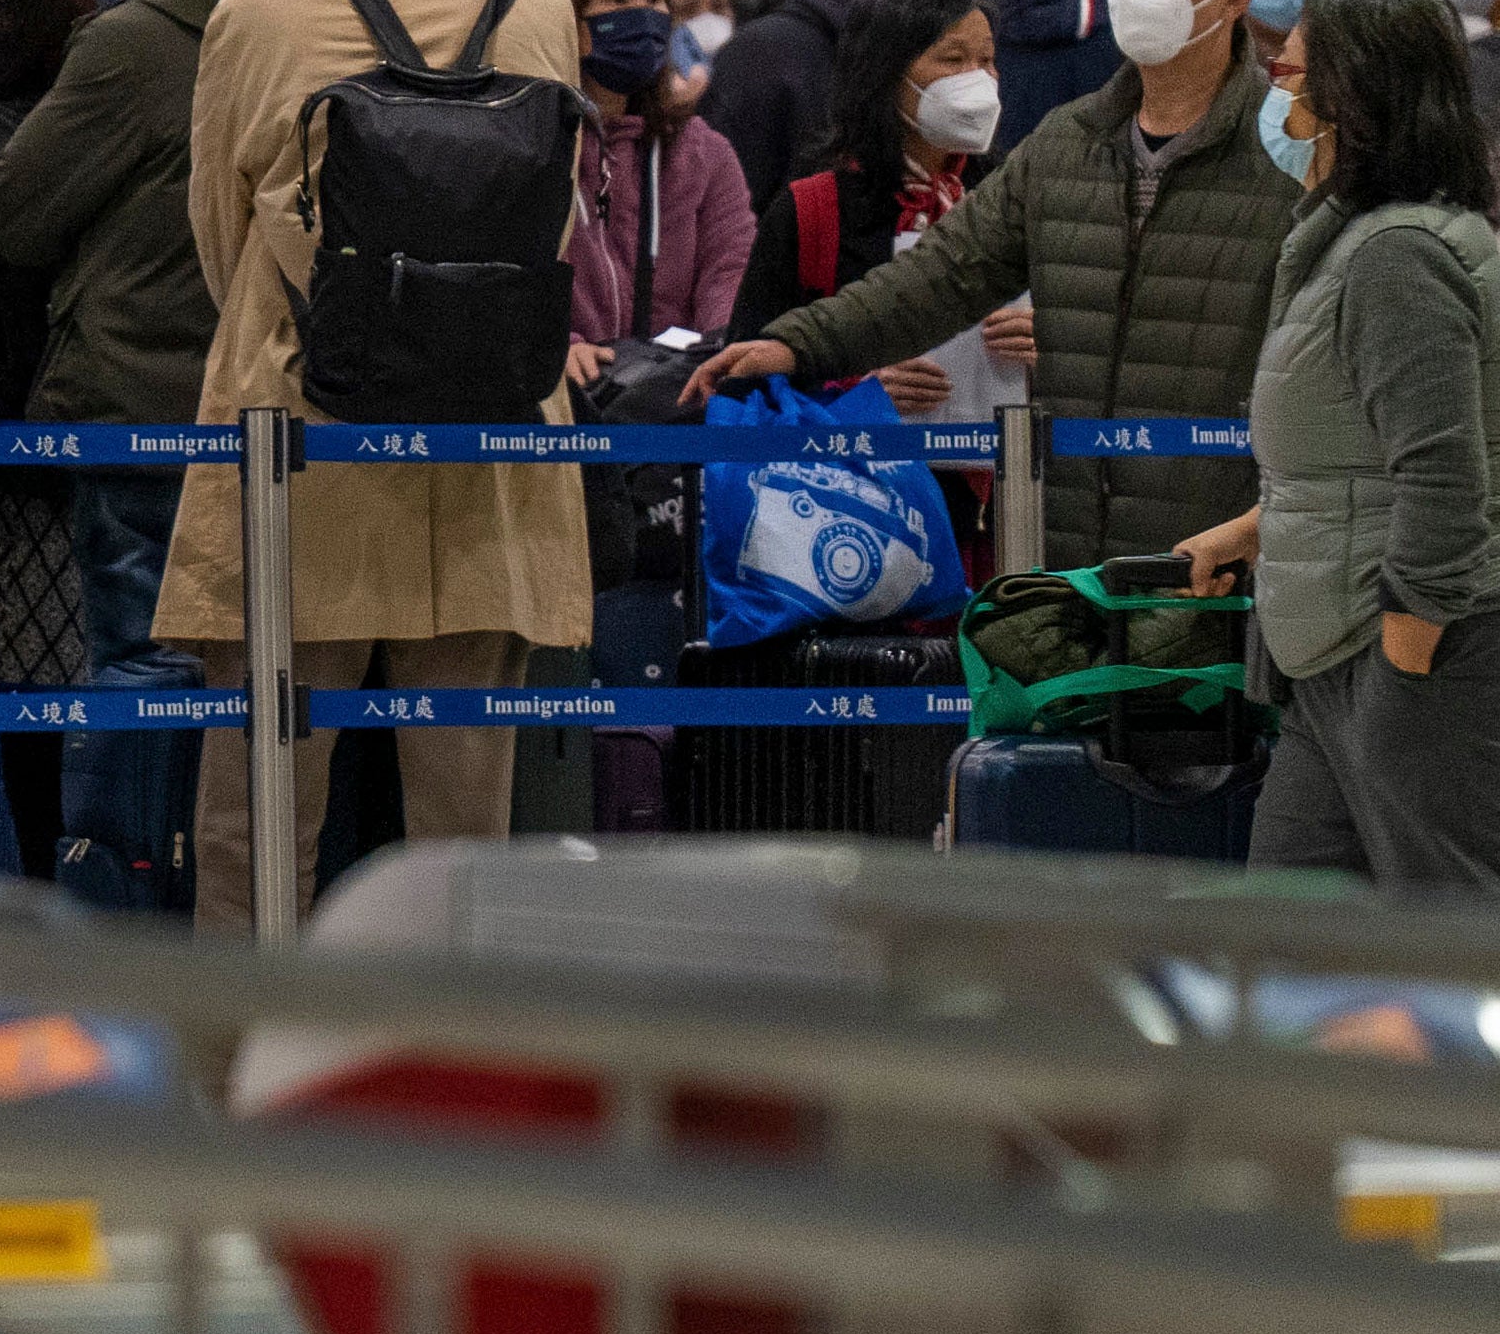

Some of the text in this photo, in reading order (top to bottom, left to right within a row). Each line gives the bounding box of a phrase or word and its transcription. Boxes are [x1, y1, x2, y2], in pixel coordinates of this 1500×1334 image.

[10, 433, 82, 458] 入境處
[356, 431, 430, 457] 入境處
[479, 430, 612, 455] Immigration
[801, 432, 875, 457] 入境處
[1094, 425, 1153, 451] 入境處
[15, 699, 89, 725] 入境處
[363, 693, 436, 720] 入境處
[484, 693, 616, 720] Immigration
[804, 693, 878, 720] 入境處
